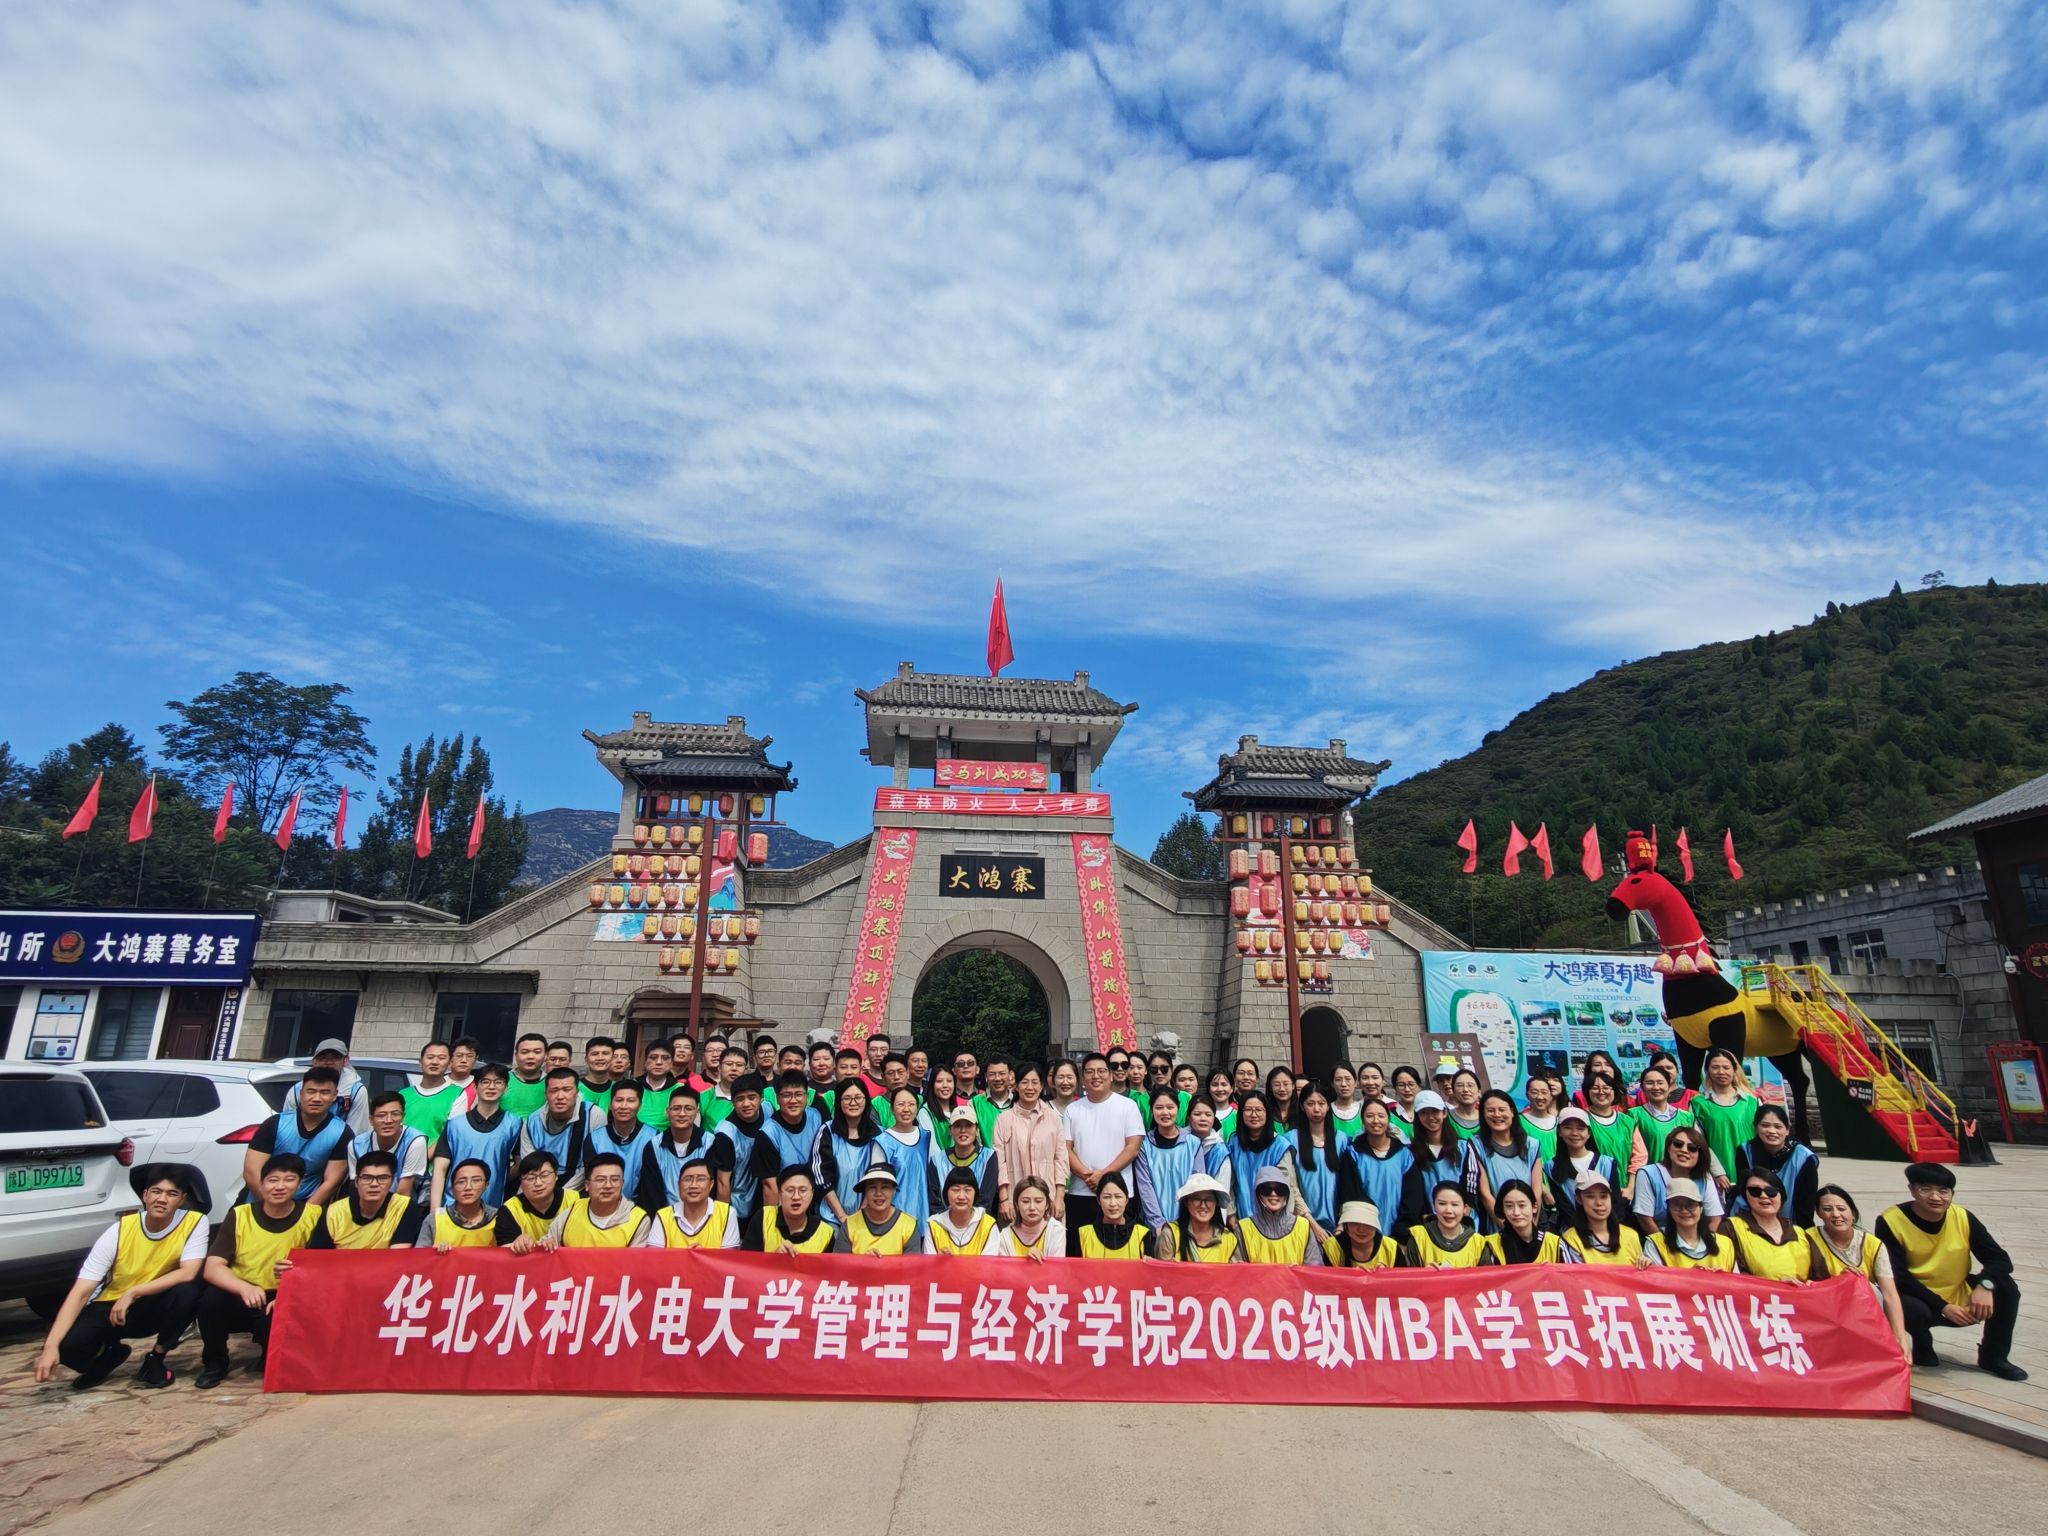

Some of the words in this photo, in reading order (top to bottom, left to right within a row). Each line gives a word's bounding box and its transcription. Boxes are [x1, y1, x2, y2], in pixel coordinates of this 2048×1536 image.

[889, 793, 984, 811] 森林防火
[1008, 797, 1100, 812] 人人有责
[948, 864, 1036, 893] 大鸿寨
[92, 931, 240, 966] 大鸿寨警务室
[1543, 960, 1655, 995] 大鸿寨夏有趣
[378, 1274, 1815, 1377] 华北水利水电大学管理与经济学院2026级MBA学员拓展训练
